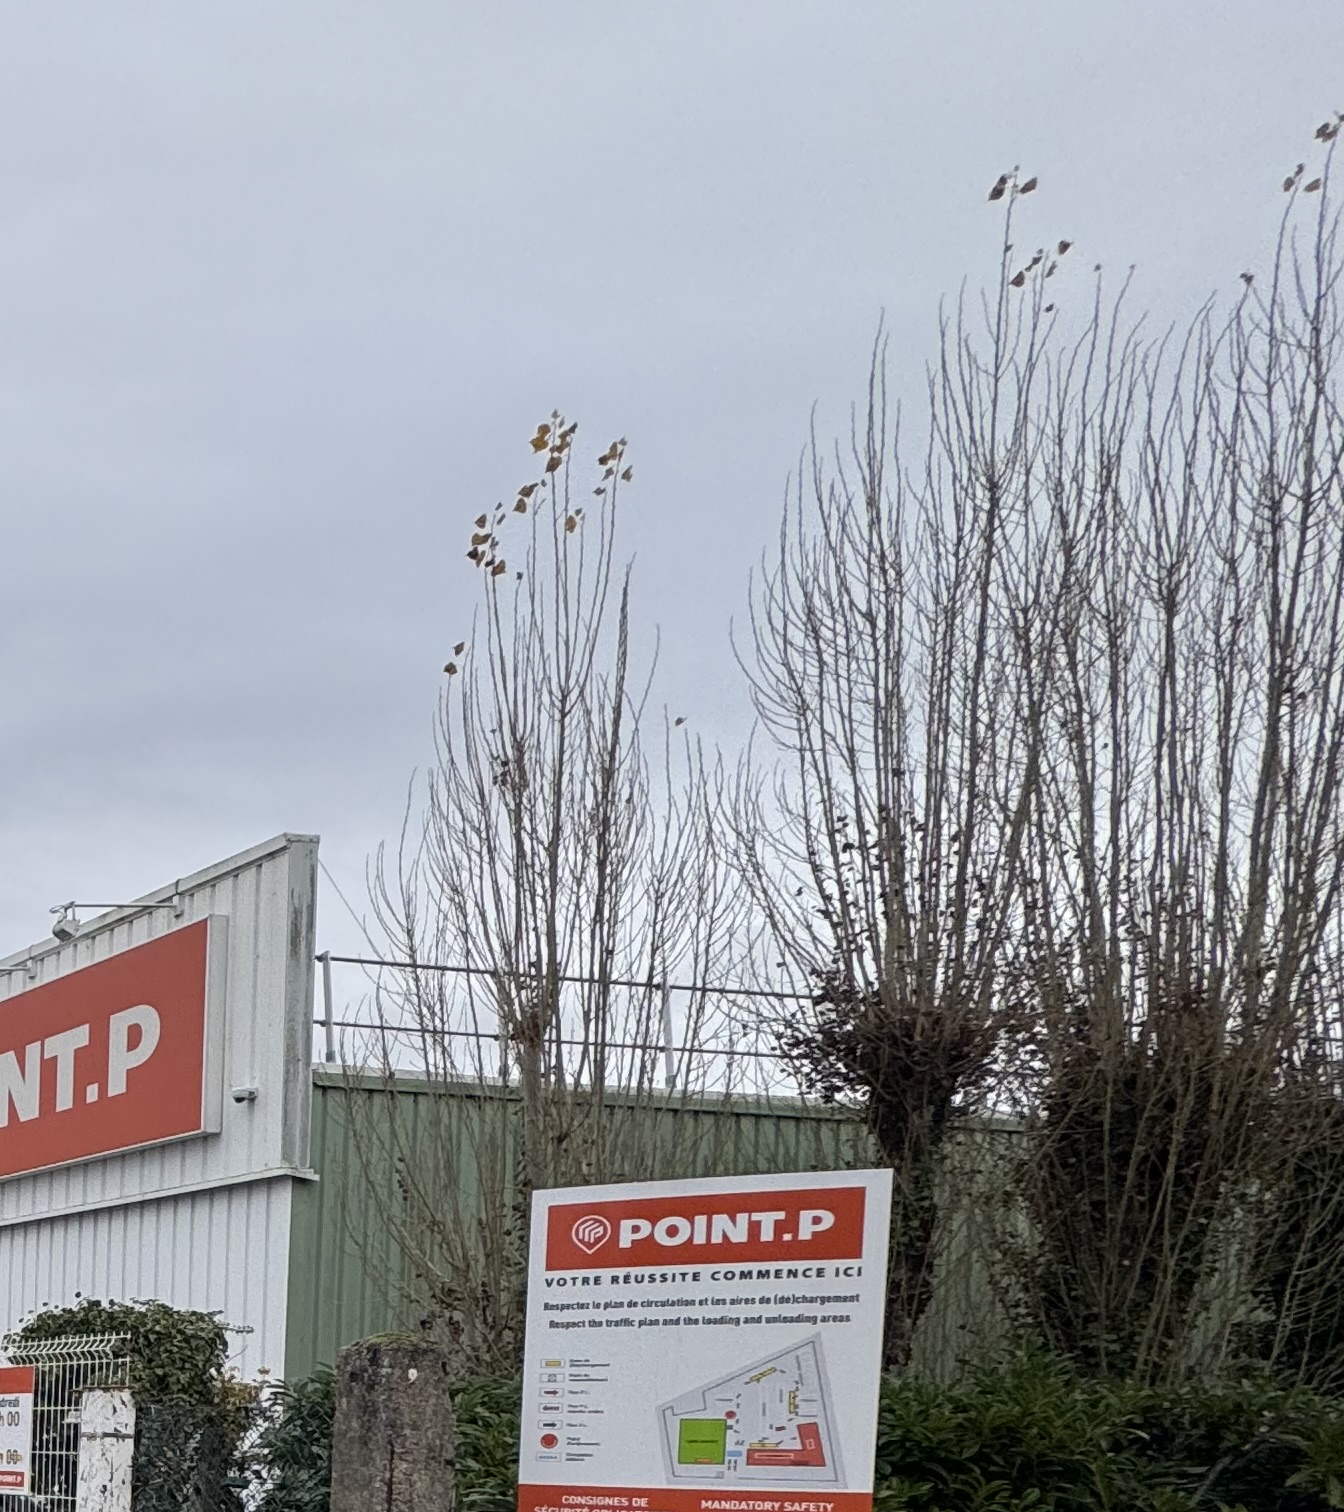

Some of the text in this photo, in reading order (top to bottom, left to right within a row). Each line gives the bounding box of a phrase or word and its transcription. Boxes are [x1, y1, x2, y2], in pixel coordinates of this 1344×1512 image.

[618, 1209, 836, 1249] POINT.P
[544, 1266, 863, 1288] VOTRE RÉUSSITE COMMENCE ICI
[543, 1293, 860, 1312] Respectez le plan de circulation et les aires de (dé)chargement
[549, 1314, 851, 1330] Respect the traffic plan and the loading and unloading areas
[561, 1495, 649, 1507] CONSIGNES DE
[700, 1499, 834, 1512] MANDATORY SAFETY
